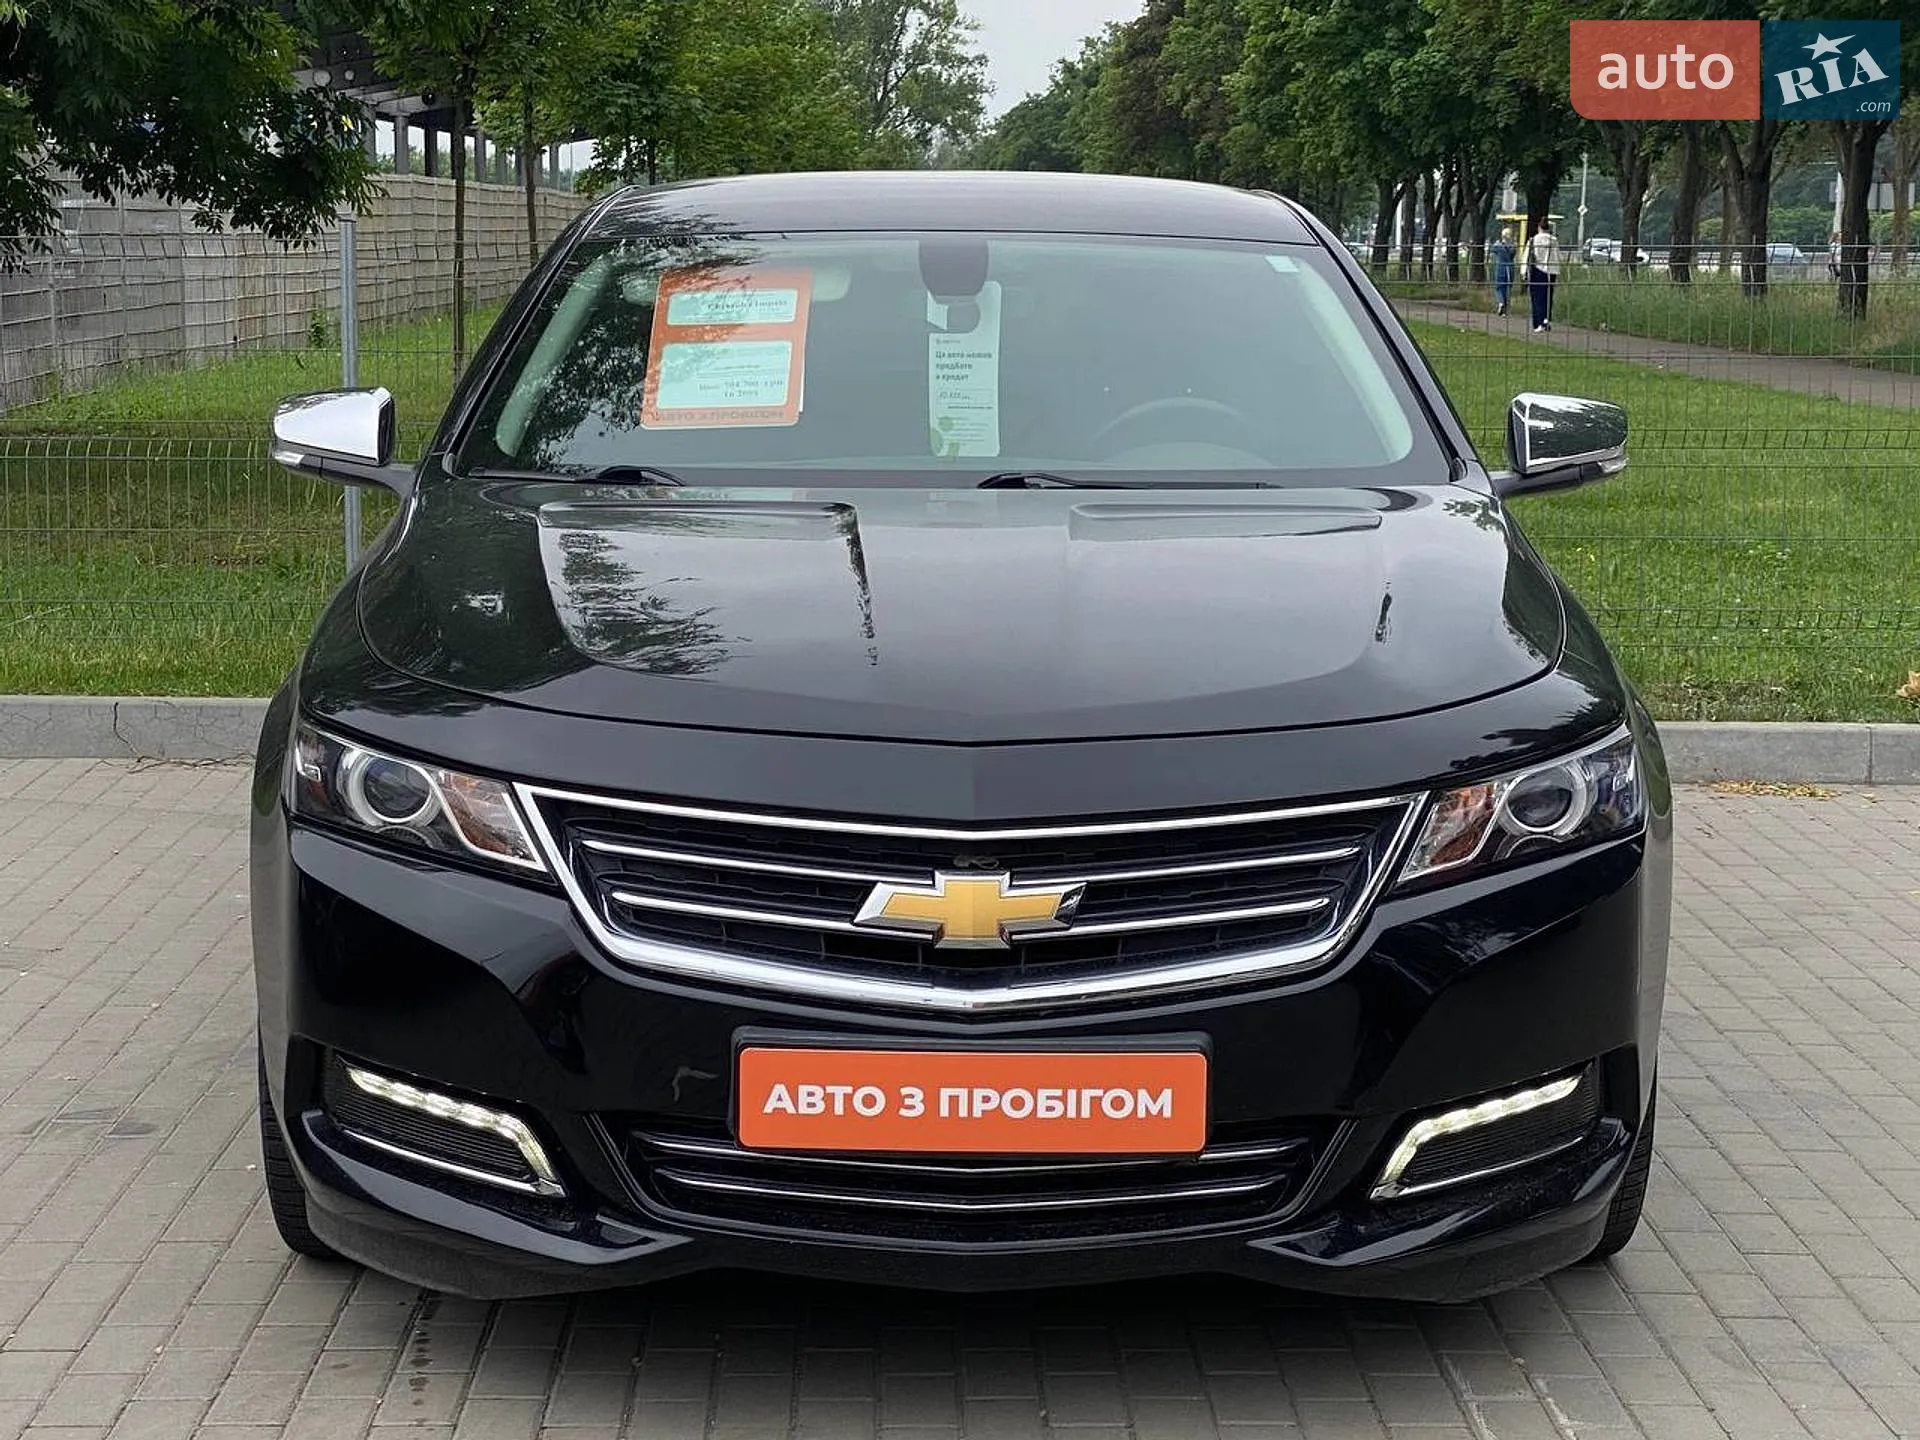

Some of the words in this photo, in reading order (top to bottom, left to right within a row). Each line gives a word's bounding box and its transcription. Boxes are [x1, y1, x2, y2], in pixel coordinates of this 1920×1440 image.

[763, 1083, 886, 1117] АВТО
[898, 1087, 925, 1117] З
[939, 1087, 1173, 1119] ПРОБІГОМ
